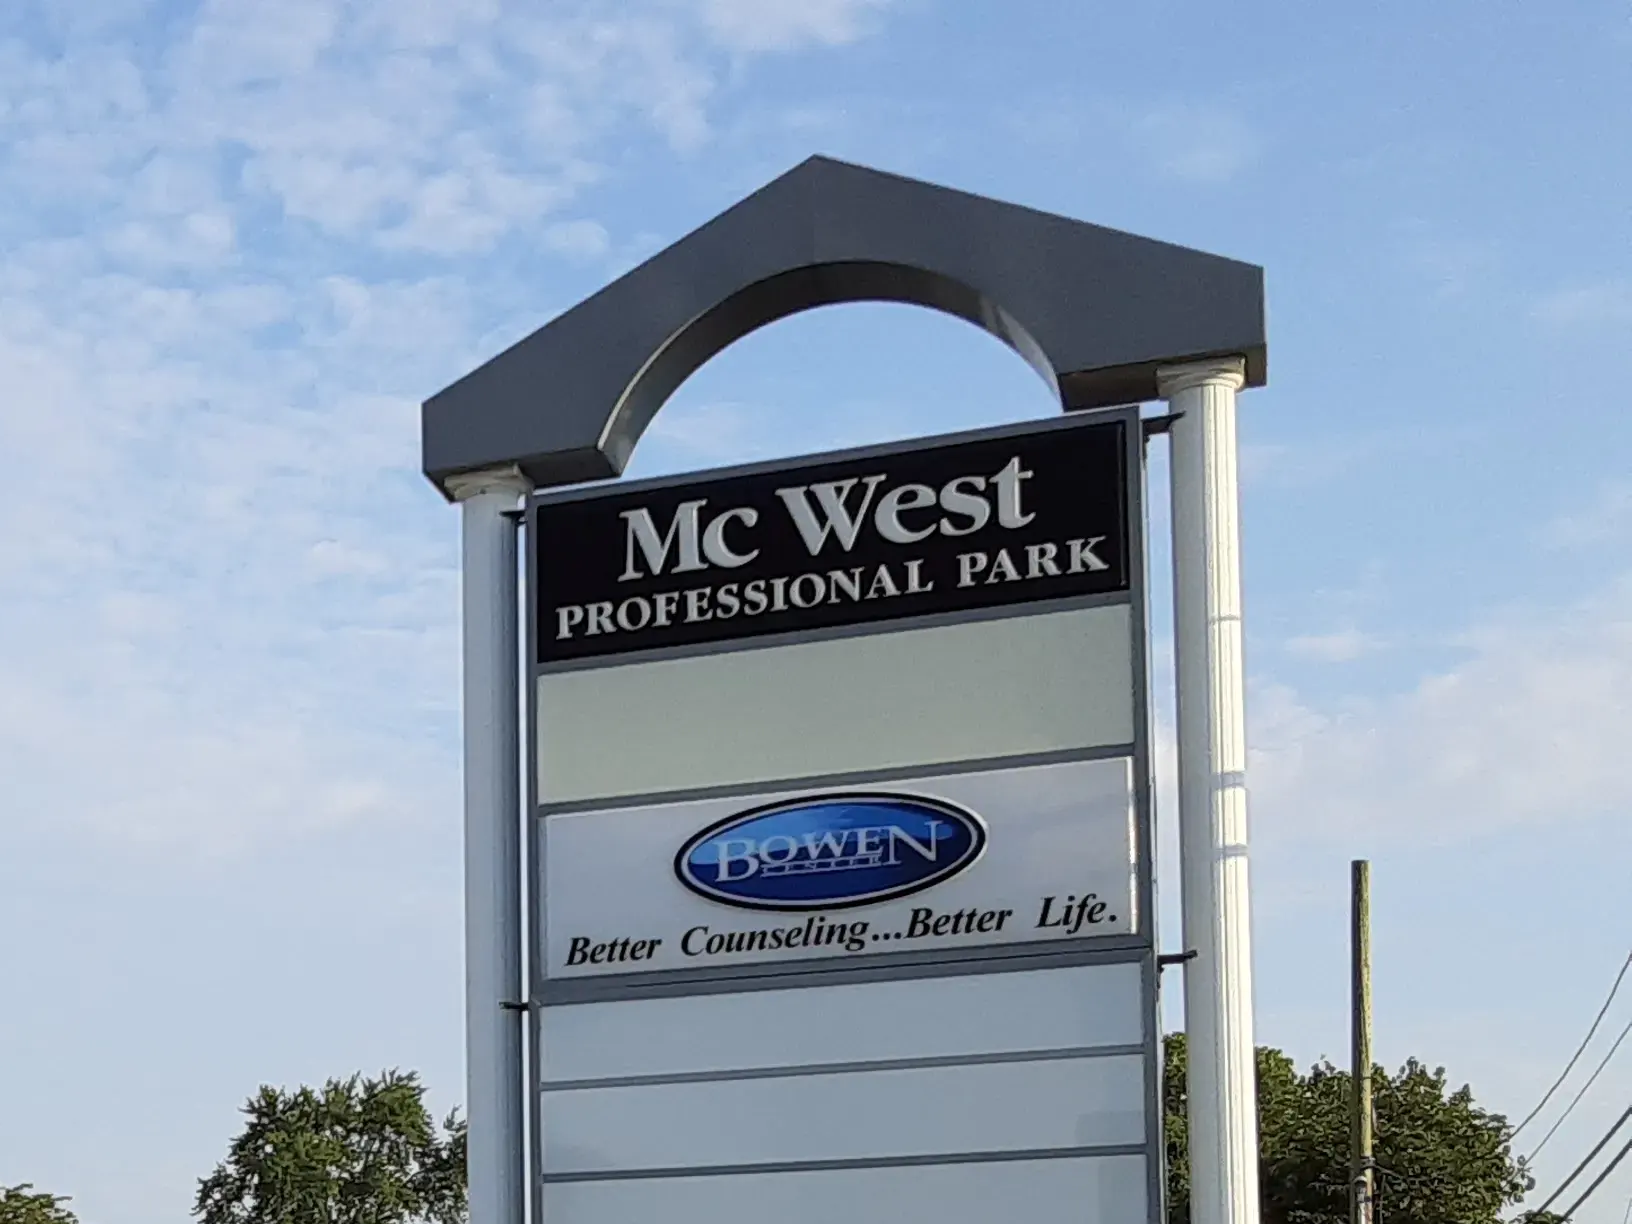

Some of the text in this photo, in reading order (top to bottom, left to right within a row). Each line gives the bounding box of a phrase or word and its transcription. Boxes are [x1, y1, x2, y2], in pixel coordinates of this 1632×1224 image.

[617, 455, 1037, 583] Mc West
[555, 534, 1110, 641] PROFESSIONAL PARK
[714, 819, 943, 883] BOWEN
[564, 933, 663, 967] Better
[1034, 892, 1118, 934] Life.
